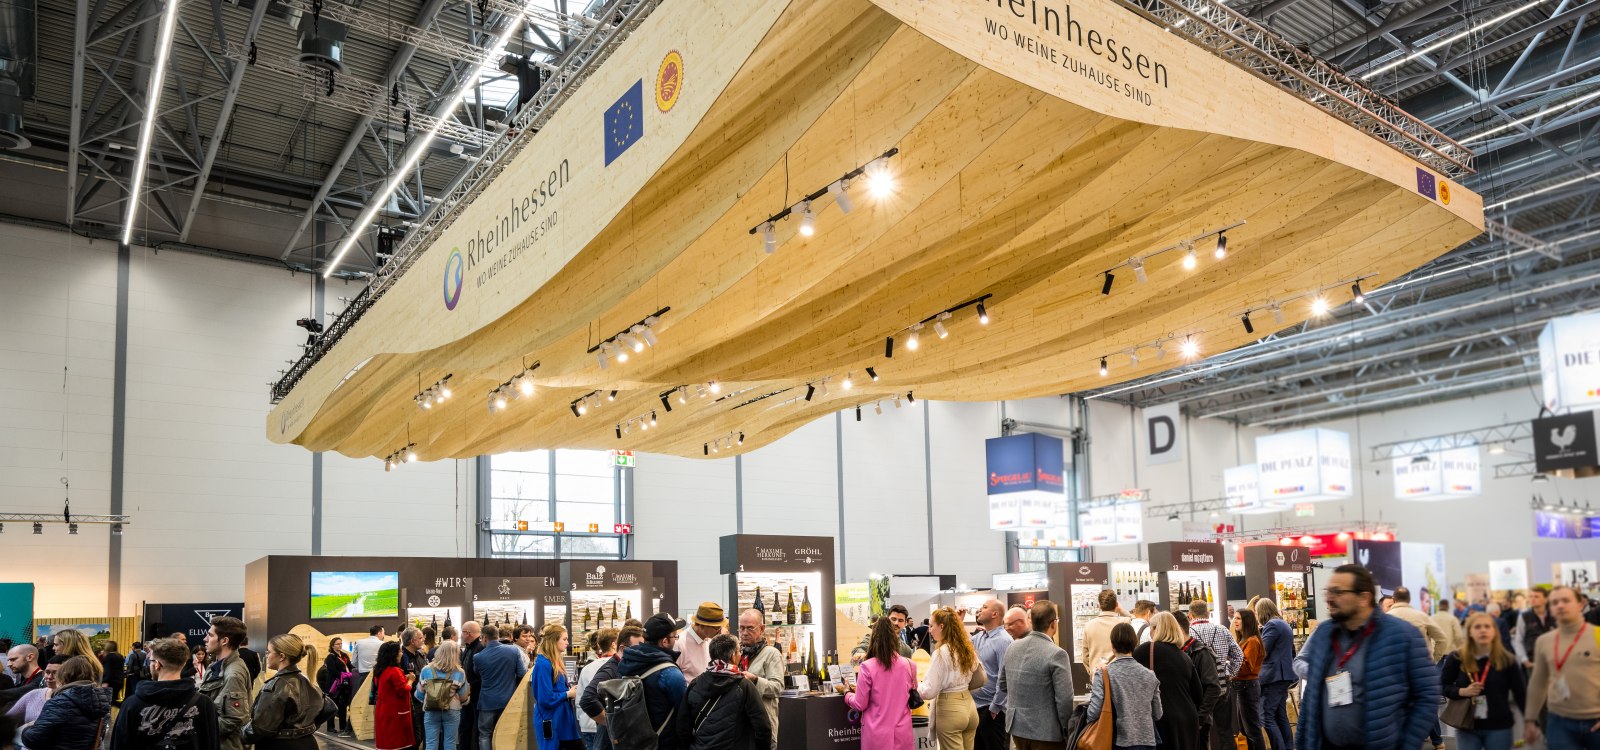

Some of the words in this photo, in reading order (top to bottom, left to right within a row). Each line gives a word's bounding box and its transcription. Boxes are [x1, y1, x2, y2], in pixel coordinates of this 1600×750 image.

[987, 0, 1168, 88] einhessen
[985, 17, 1008, 41] WO
[1013, 31, 1057, 64] WEINE
[1062, 54, 1120, 93] ZUHAUSE
[1124, 83, 1152, 107] SIND
[468, 158, 569, 271] Rheinhessen
[476, 271, 487, 288] WO
[488, 255, 507, 280] WEINE
[508, 227, 539, 263] ZUHAUSE
[541, 211, 558, 237] SIND
[1564, 351, 1593, 367] DIE
[1148, 415, 1176, 455] D
[795, 547, 822, 555] GRÖHL
[586, 572, 604, 580] Balz
[740, 564, 745, 572] 1
[544, 576, 555, 587] EN
[571, 583, 577, 591] 3
